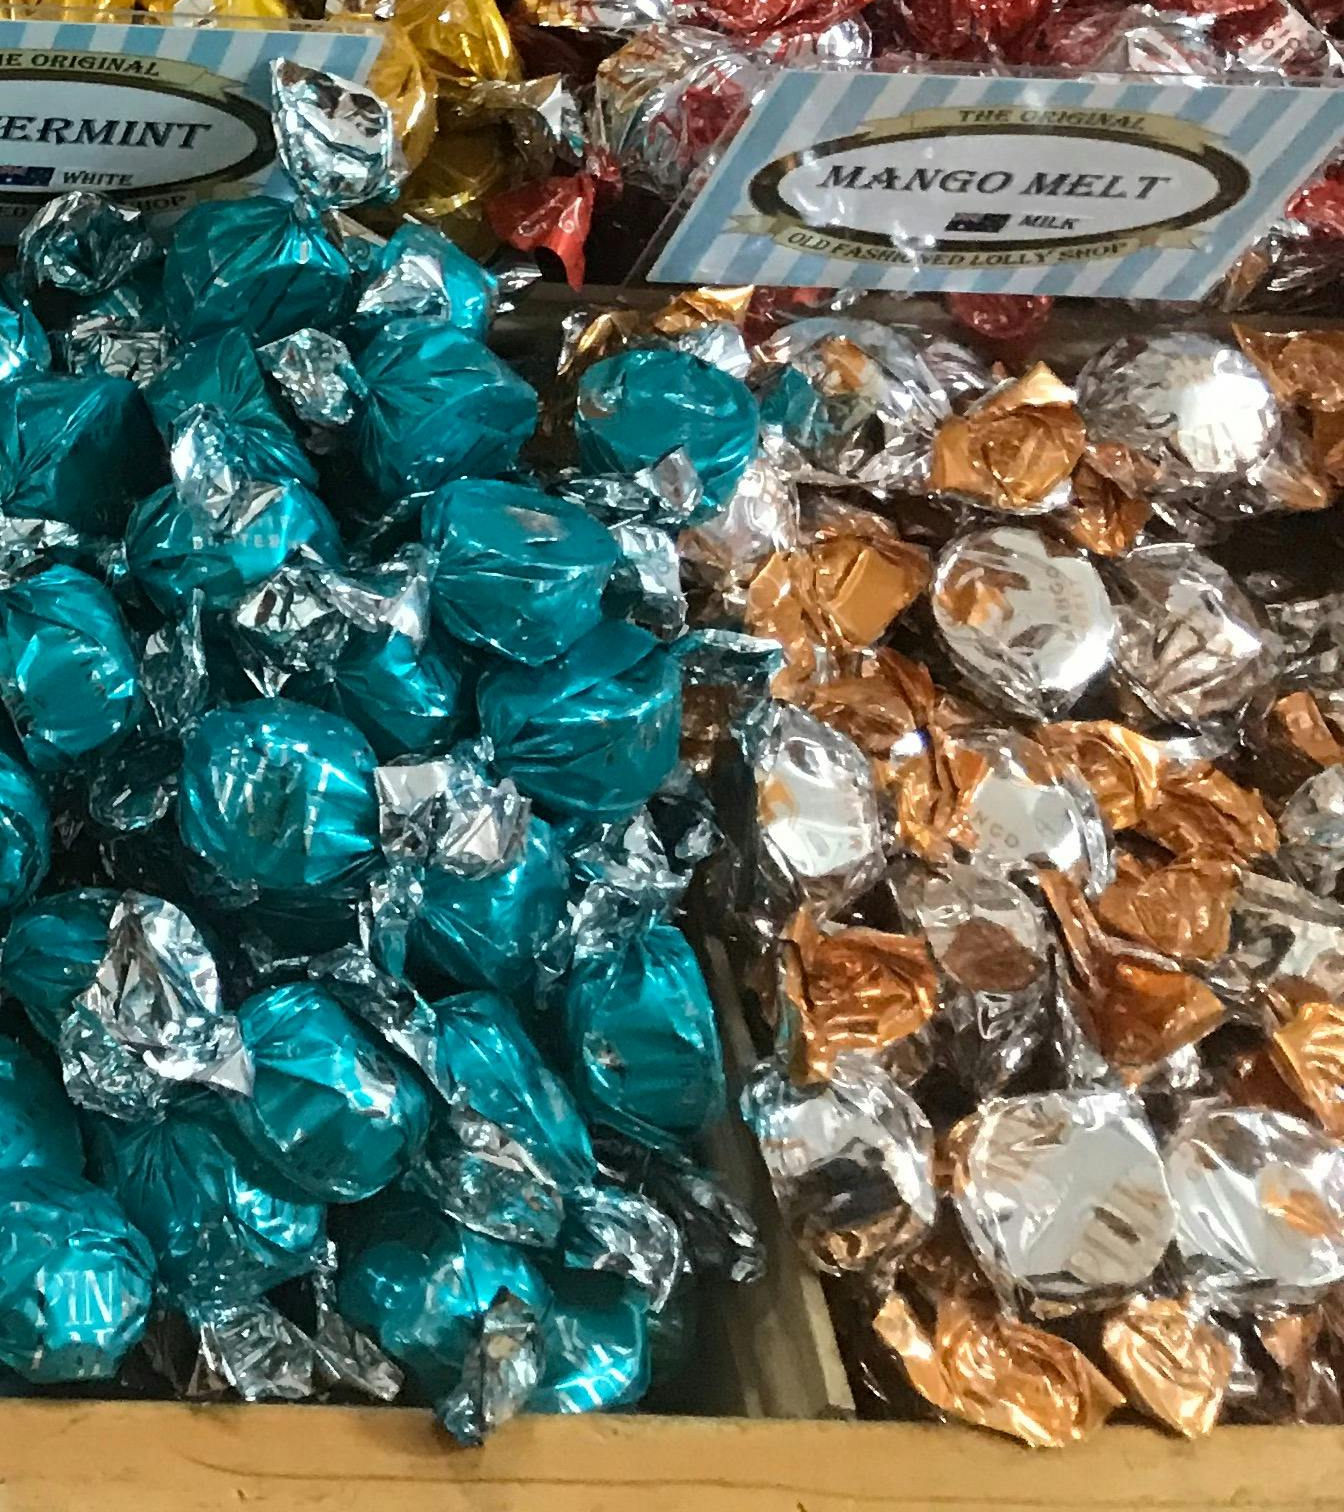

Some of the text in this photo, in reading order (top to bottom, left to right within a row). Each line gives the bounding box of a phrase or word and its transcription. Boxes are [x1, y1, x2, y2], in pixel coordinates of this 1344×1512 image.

[31, 52, 160, 77] ORIGINAL
[958, 109, 1147, 131] THE ORIGINAL
[62, 171, 133, 187] WHITE
[815, 164, 1172, 200] MANGO MELT
[134, 194, 187, 212] HOP
[1017, 216, 1081, 231] MILK
[786, 232, 1128, 267] OLD FASHIONED LOLLY SHOP
